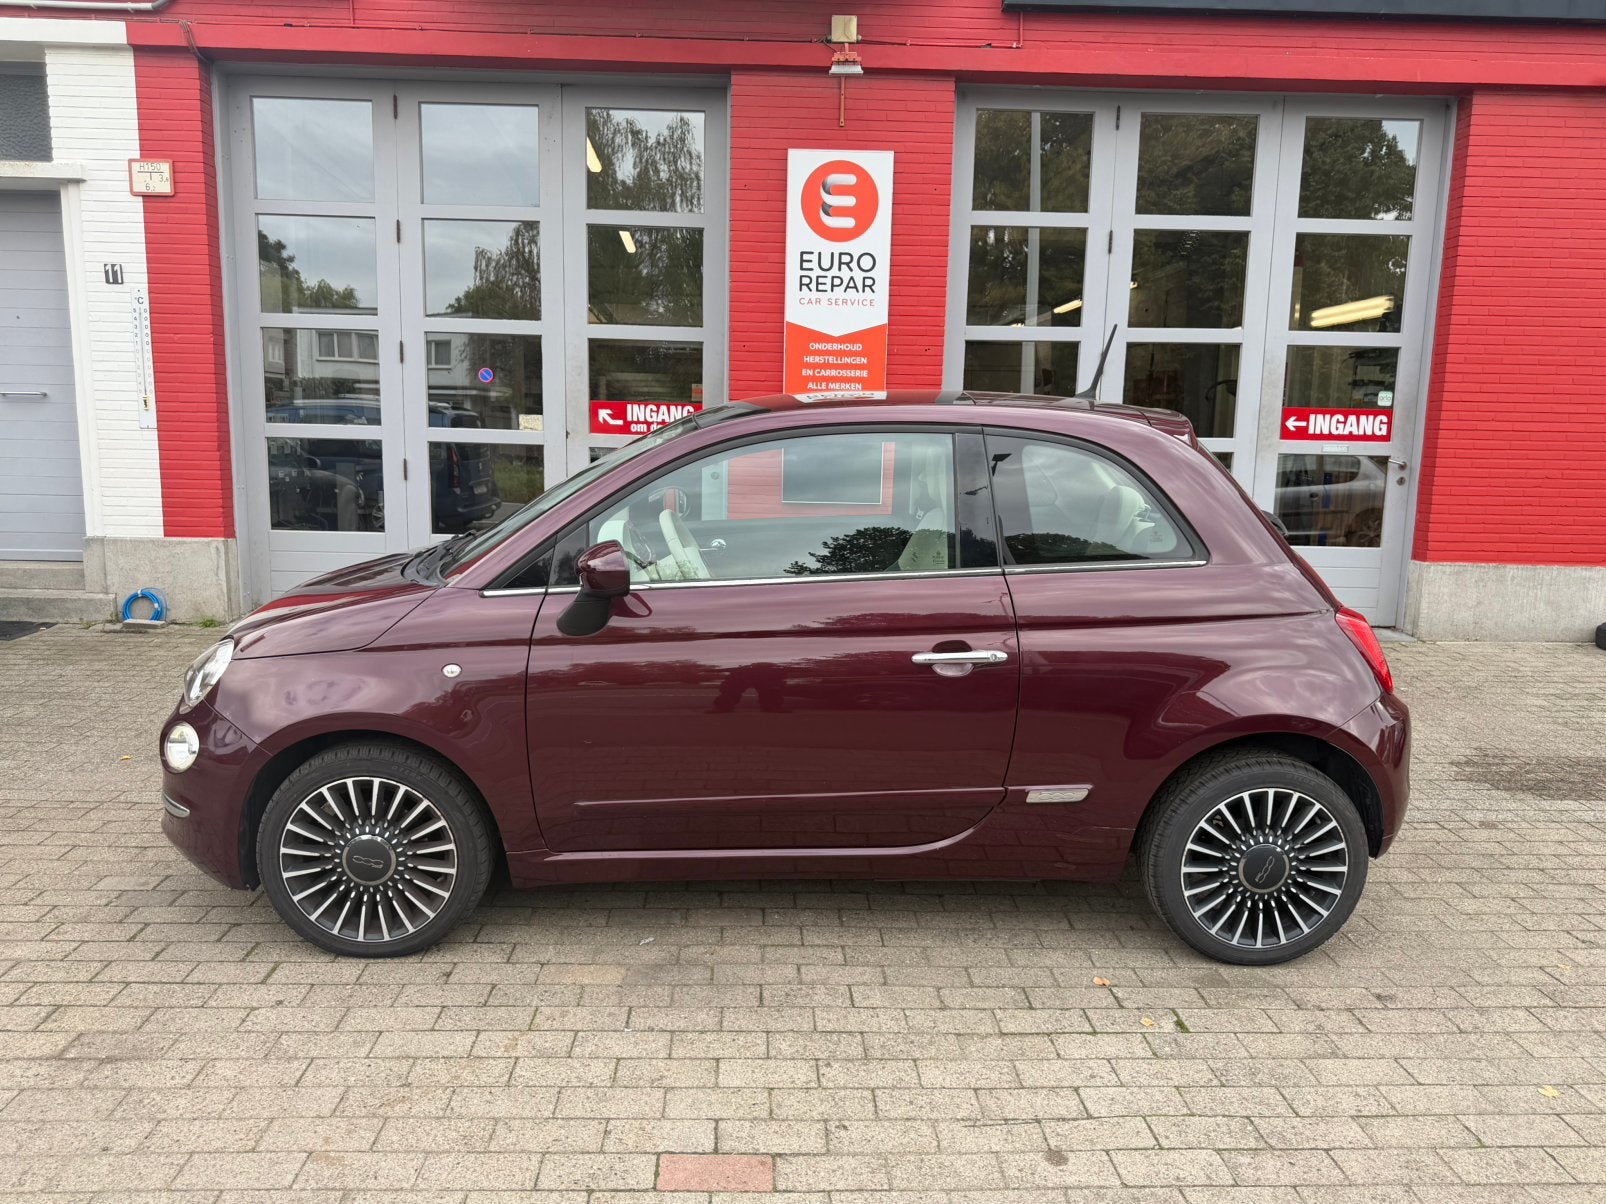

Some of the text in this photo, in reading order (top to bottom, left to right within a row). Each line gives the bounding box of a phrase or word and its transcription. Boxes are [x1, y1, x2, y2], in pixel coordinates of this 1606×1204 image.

[139, 162, 162, 171] H150
[799, 251, 877, 273] EURO
[104, 264, 122, 284] 11
[798, 275, 876, 294] REPAR
[798, 297, 875, 307] CAR SERVICE
[809, 342, 863, 351] ONDERHOUD
[803, 355, 868, 364] HERSTELLINGEN
[801, 368, 869, 378] EN CARROSSERIE
[807, 381, 862, 391] ALLE MERKEN
[630, 423, 648, 432] om
[1308, 413, 1388, 436] INGANG
